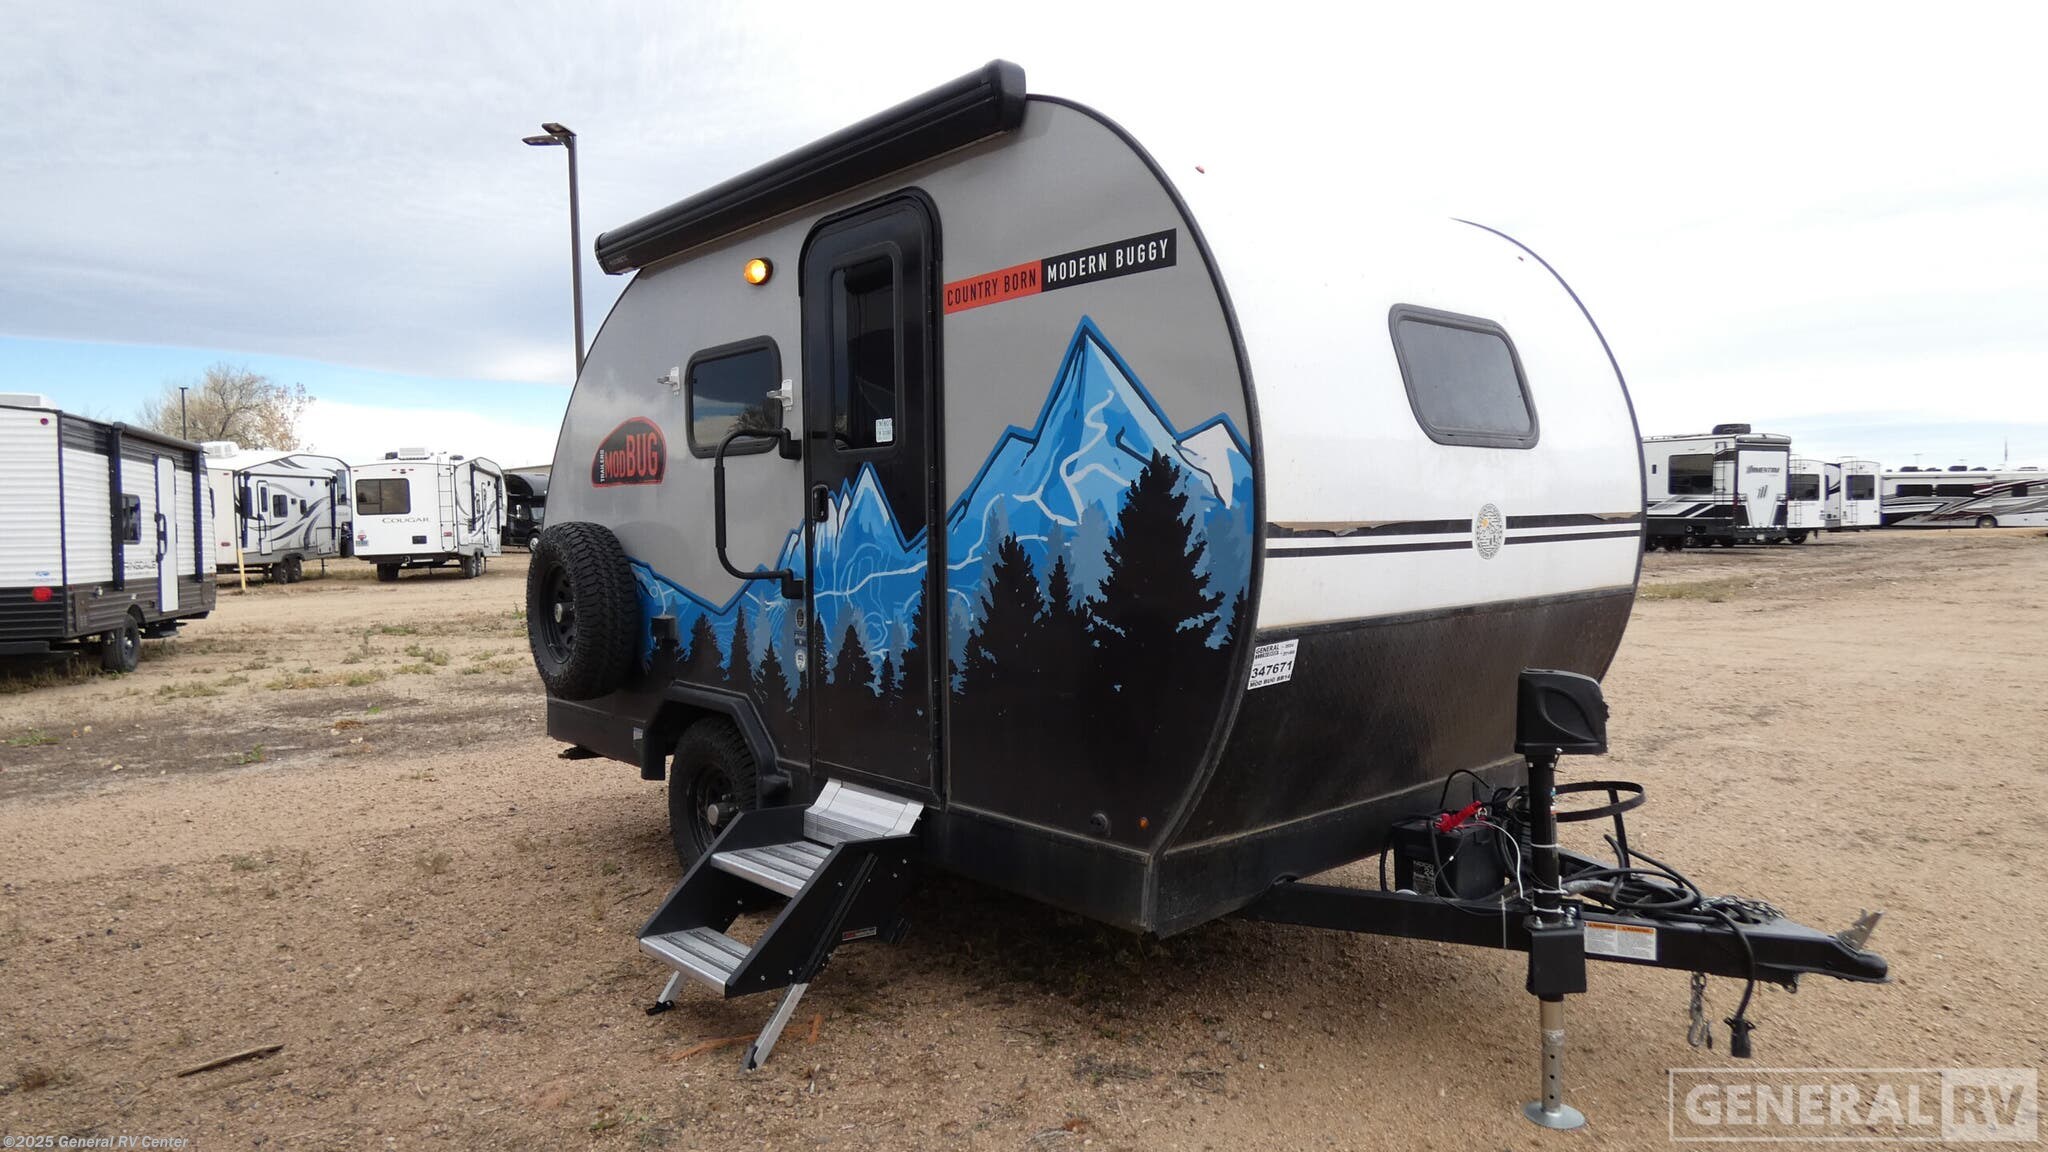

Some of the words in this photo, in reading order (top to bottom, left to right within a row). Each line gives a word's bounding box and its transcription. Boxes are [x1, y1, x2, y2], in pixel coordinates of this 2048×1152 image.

[947, 279, 998, 305] COUNTRY
[1004, 269, 1037, 293] BORN
[1048, 252, 1107, 282] MODERN
[1116, 239, 1168, 268] BUGGY
[1255, 643, 1280, 654] GENERAL
[1251, 661, 1292, 678] 347671
